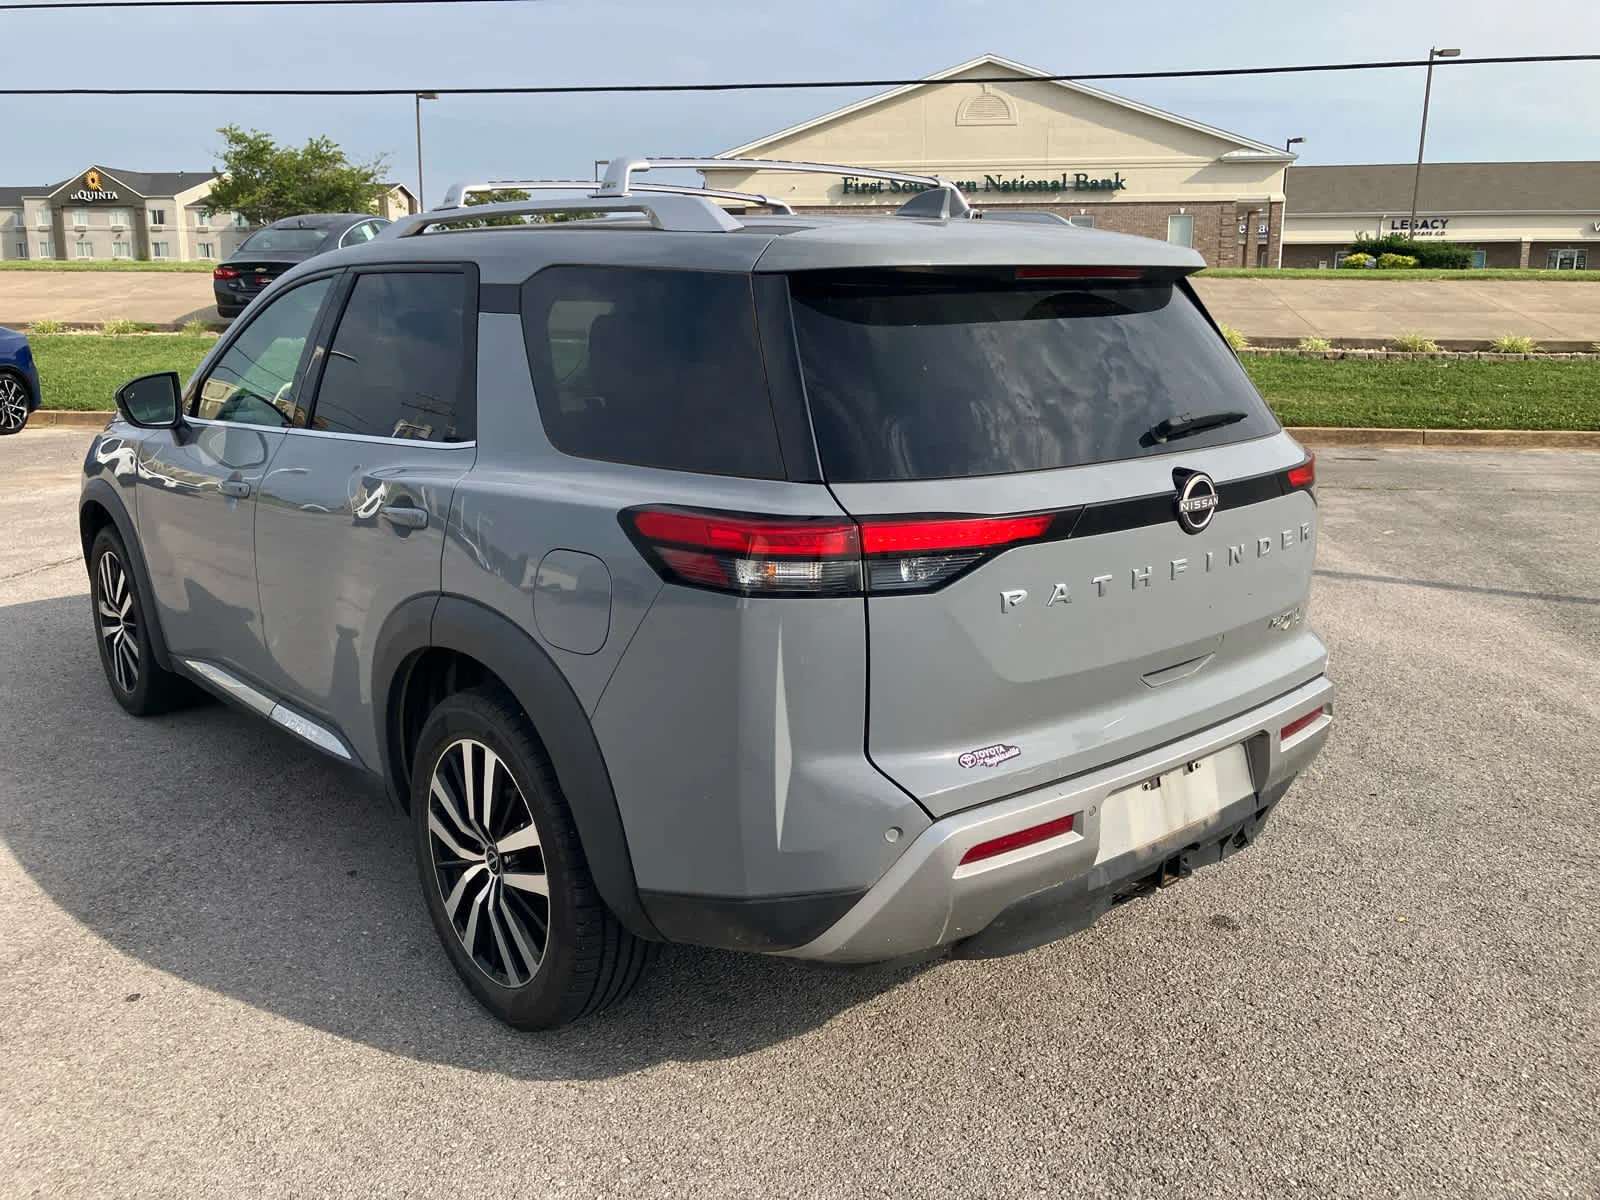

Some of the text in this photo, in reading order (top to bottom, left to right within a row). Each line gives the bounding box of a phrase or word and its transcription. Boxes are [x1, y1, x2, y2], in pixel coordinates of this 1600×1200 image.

[842, 177, 884, 194] First
[984, 173, 1067, 192] National
[1074, 172, 1126, 191] Bank
[78, 190, 118, 201] QUINTA
[1180, 495, 1218, 511] NISSAN
[1000, 521, 1312, 614] PATHFINDER
[973, 746, 1005, 759] TOYOTA
